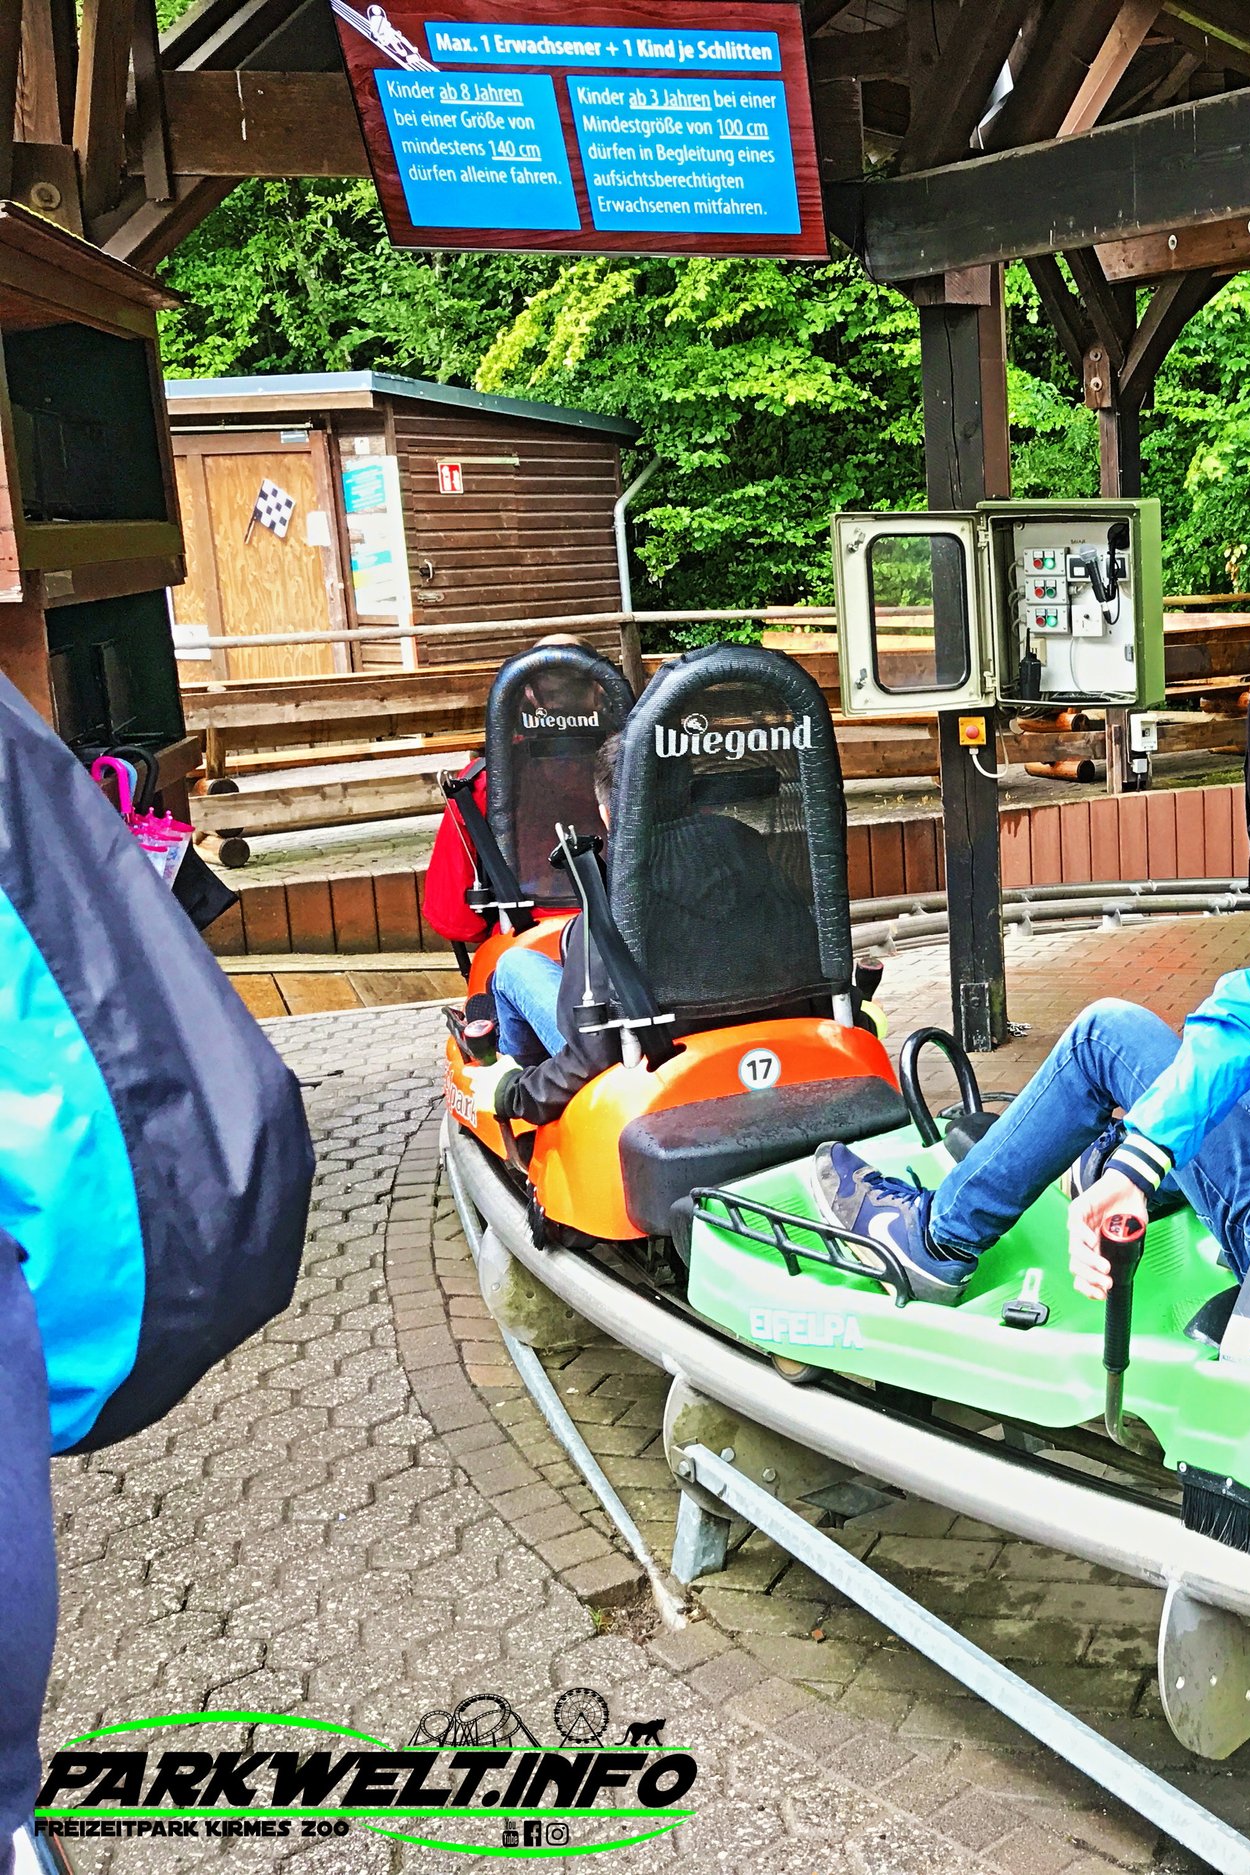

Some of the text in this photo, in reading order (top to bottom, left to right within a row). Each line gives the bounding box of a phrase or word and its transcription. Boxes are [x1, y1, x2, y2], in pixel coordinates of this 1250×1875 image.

[435, 33, 772, 62] Max. 1 Erwachsener + 1 Kind je Schlitten
[386, 80, 522, 102] Kinder ab 8 Jahren
[577, 87, 776, 109] Kinder ab 3 Jahren bei einer
[394, 109, 535, 130] bei einer Größe von
[582, 115, 768, 138] Mindestgröße von 100 cm
[401, 138, 541, 158] mindestens 140 cm
[588, 143, 775, 166] dürfen in Begleitung eines
[408, 164, 562, 185] dürfen alleine fahren.
[593, 170, 744, 193] aufsichtsberechtigten
[597, 196, 767, 215] Erwachsenen mitfahren.
[521, 709, 599, 731] Wiegand
[655, 715, 813, 760] Wiegand
[746, 1058, 773, 1081] 17
